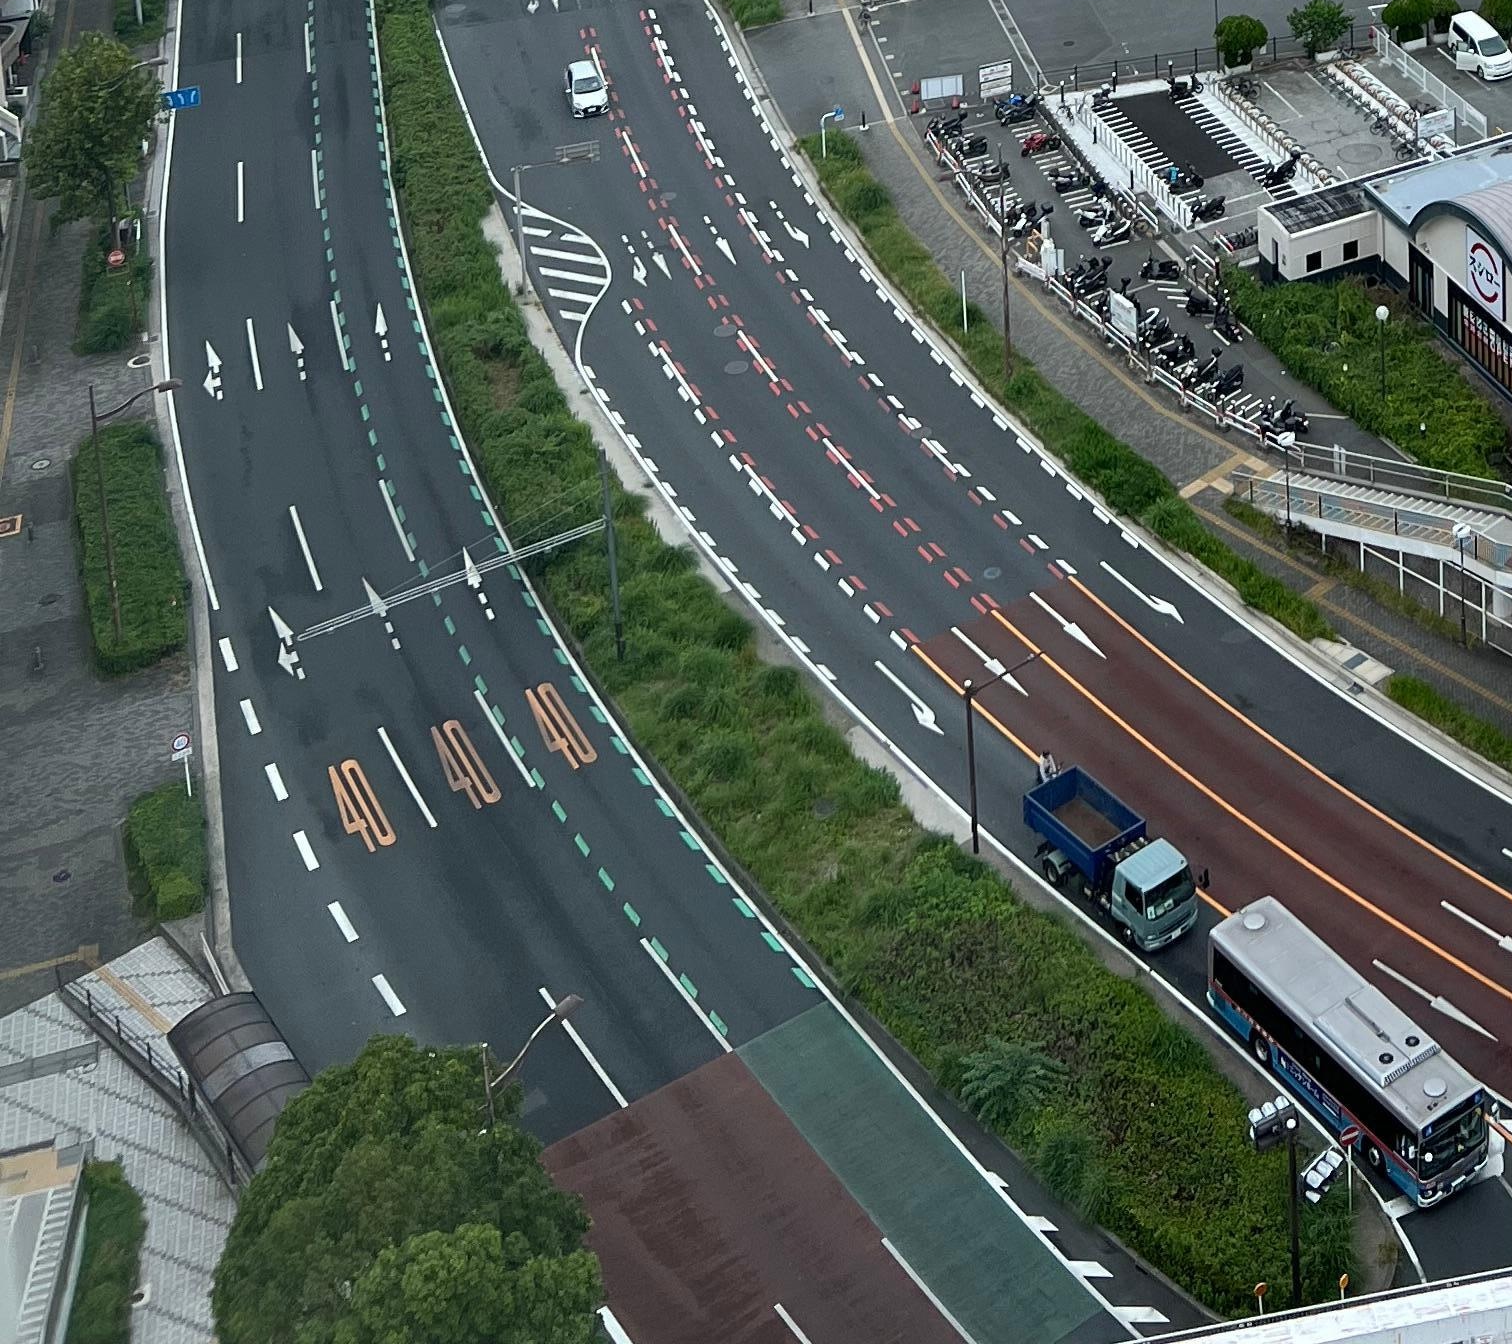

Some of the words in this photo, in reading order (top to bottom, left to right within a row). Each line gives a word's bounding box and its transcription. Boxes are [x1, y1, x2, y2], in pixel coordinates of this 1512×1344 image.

[1469, 256, 1501, 288] スシロー
[431, 719, 502, 810] 40
[525, 682, 598, 770] 40
[328, 759, 398, 853] 40
